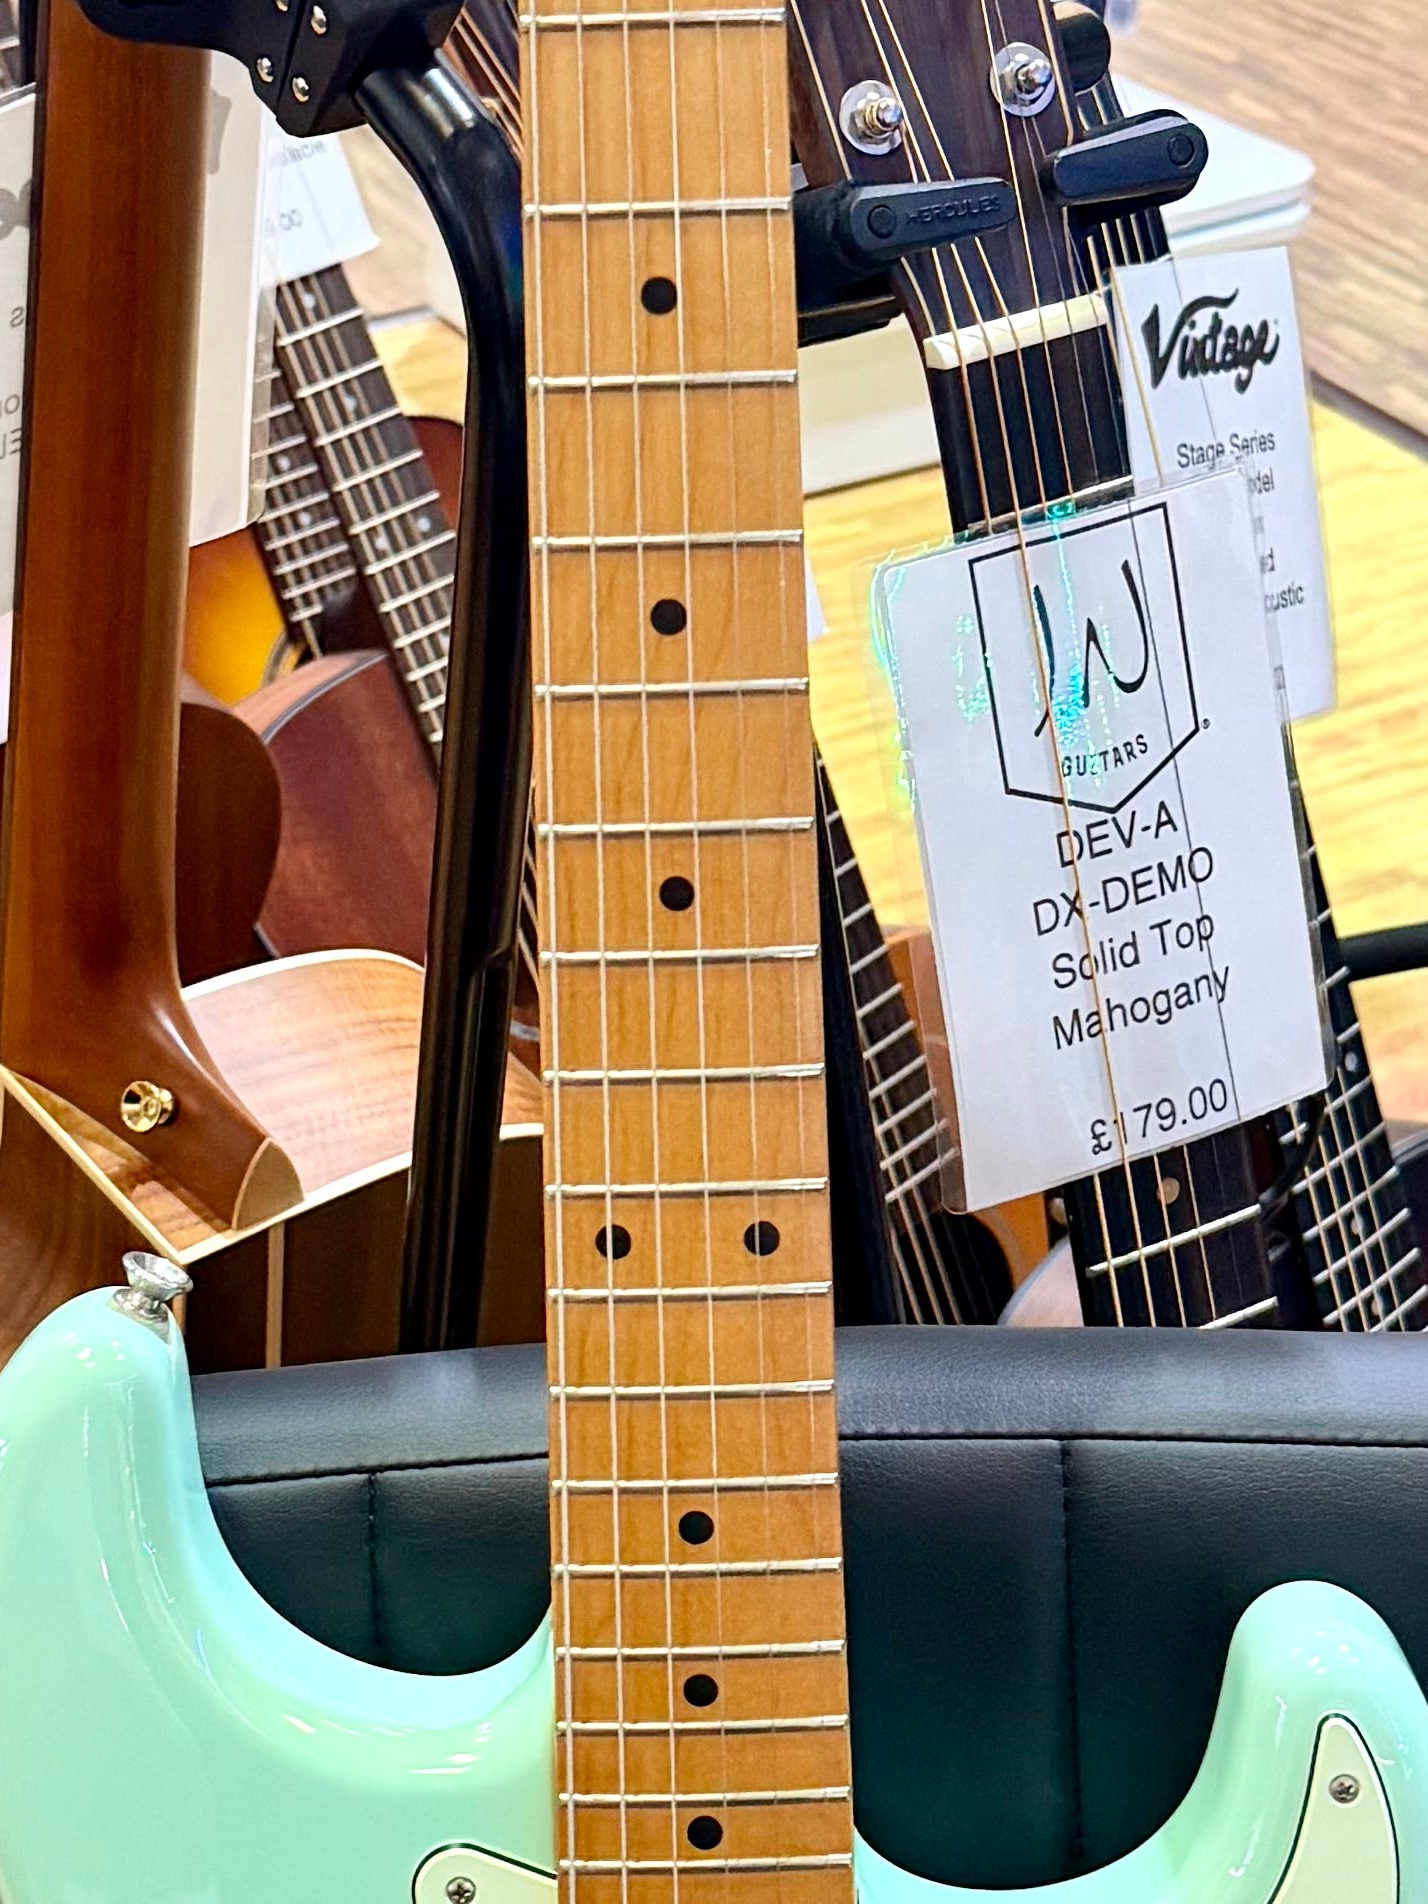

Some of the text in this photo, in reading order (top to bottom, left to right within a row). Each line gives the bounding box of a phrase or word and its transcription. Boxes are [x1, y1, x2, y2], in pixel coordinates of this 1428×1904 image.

[906, 193, 1001, 225] HERCULES
[1140, 287, 1281, 395] Vintage
[1176, 430, 1276, 471] Stage Series
[1056, 799, 1179, 869] DEV-A
[1033, 846, 1214, 936] DX-DEMO
[1051, 913, 1216, 990] Solid Top
[1052, 966, 1230, 1050] Mahogany
[1090, 1078, 1228, 1156] £179.00
